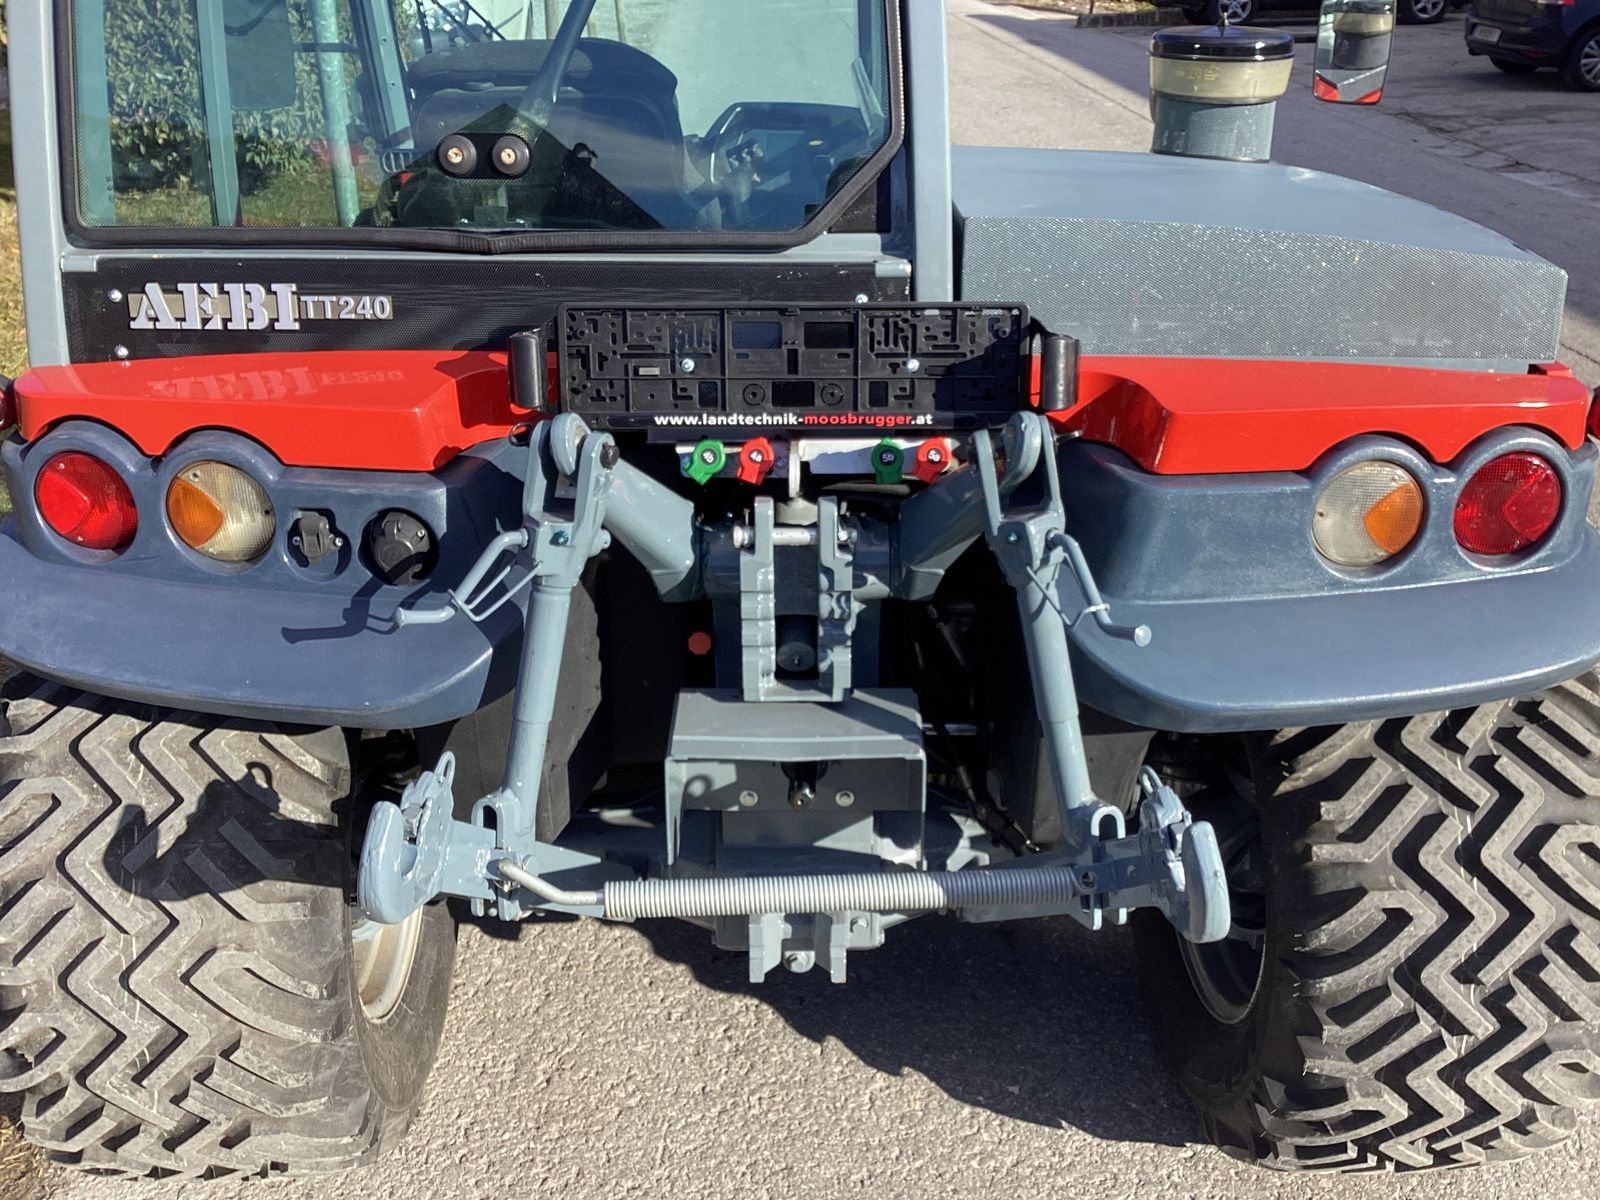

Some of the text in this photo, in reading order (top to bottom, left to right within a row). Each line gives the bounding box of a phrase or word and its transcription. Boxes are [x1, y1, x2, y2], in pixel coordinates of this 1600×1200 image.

[130, 282, 391, 330] AEBI TT240
[654, 412, 933, 427] www.landtechnik-moosbrugger.at
[750, 451, 762, 463] 4a
[882, 453, 895, 463] 5b
